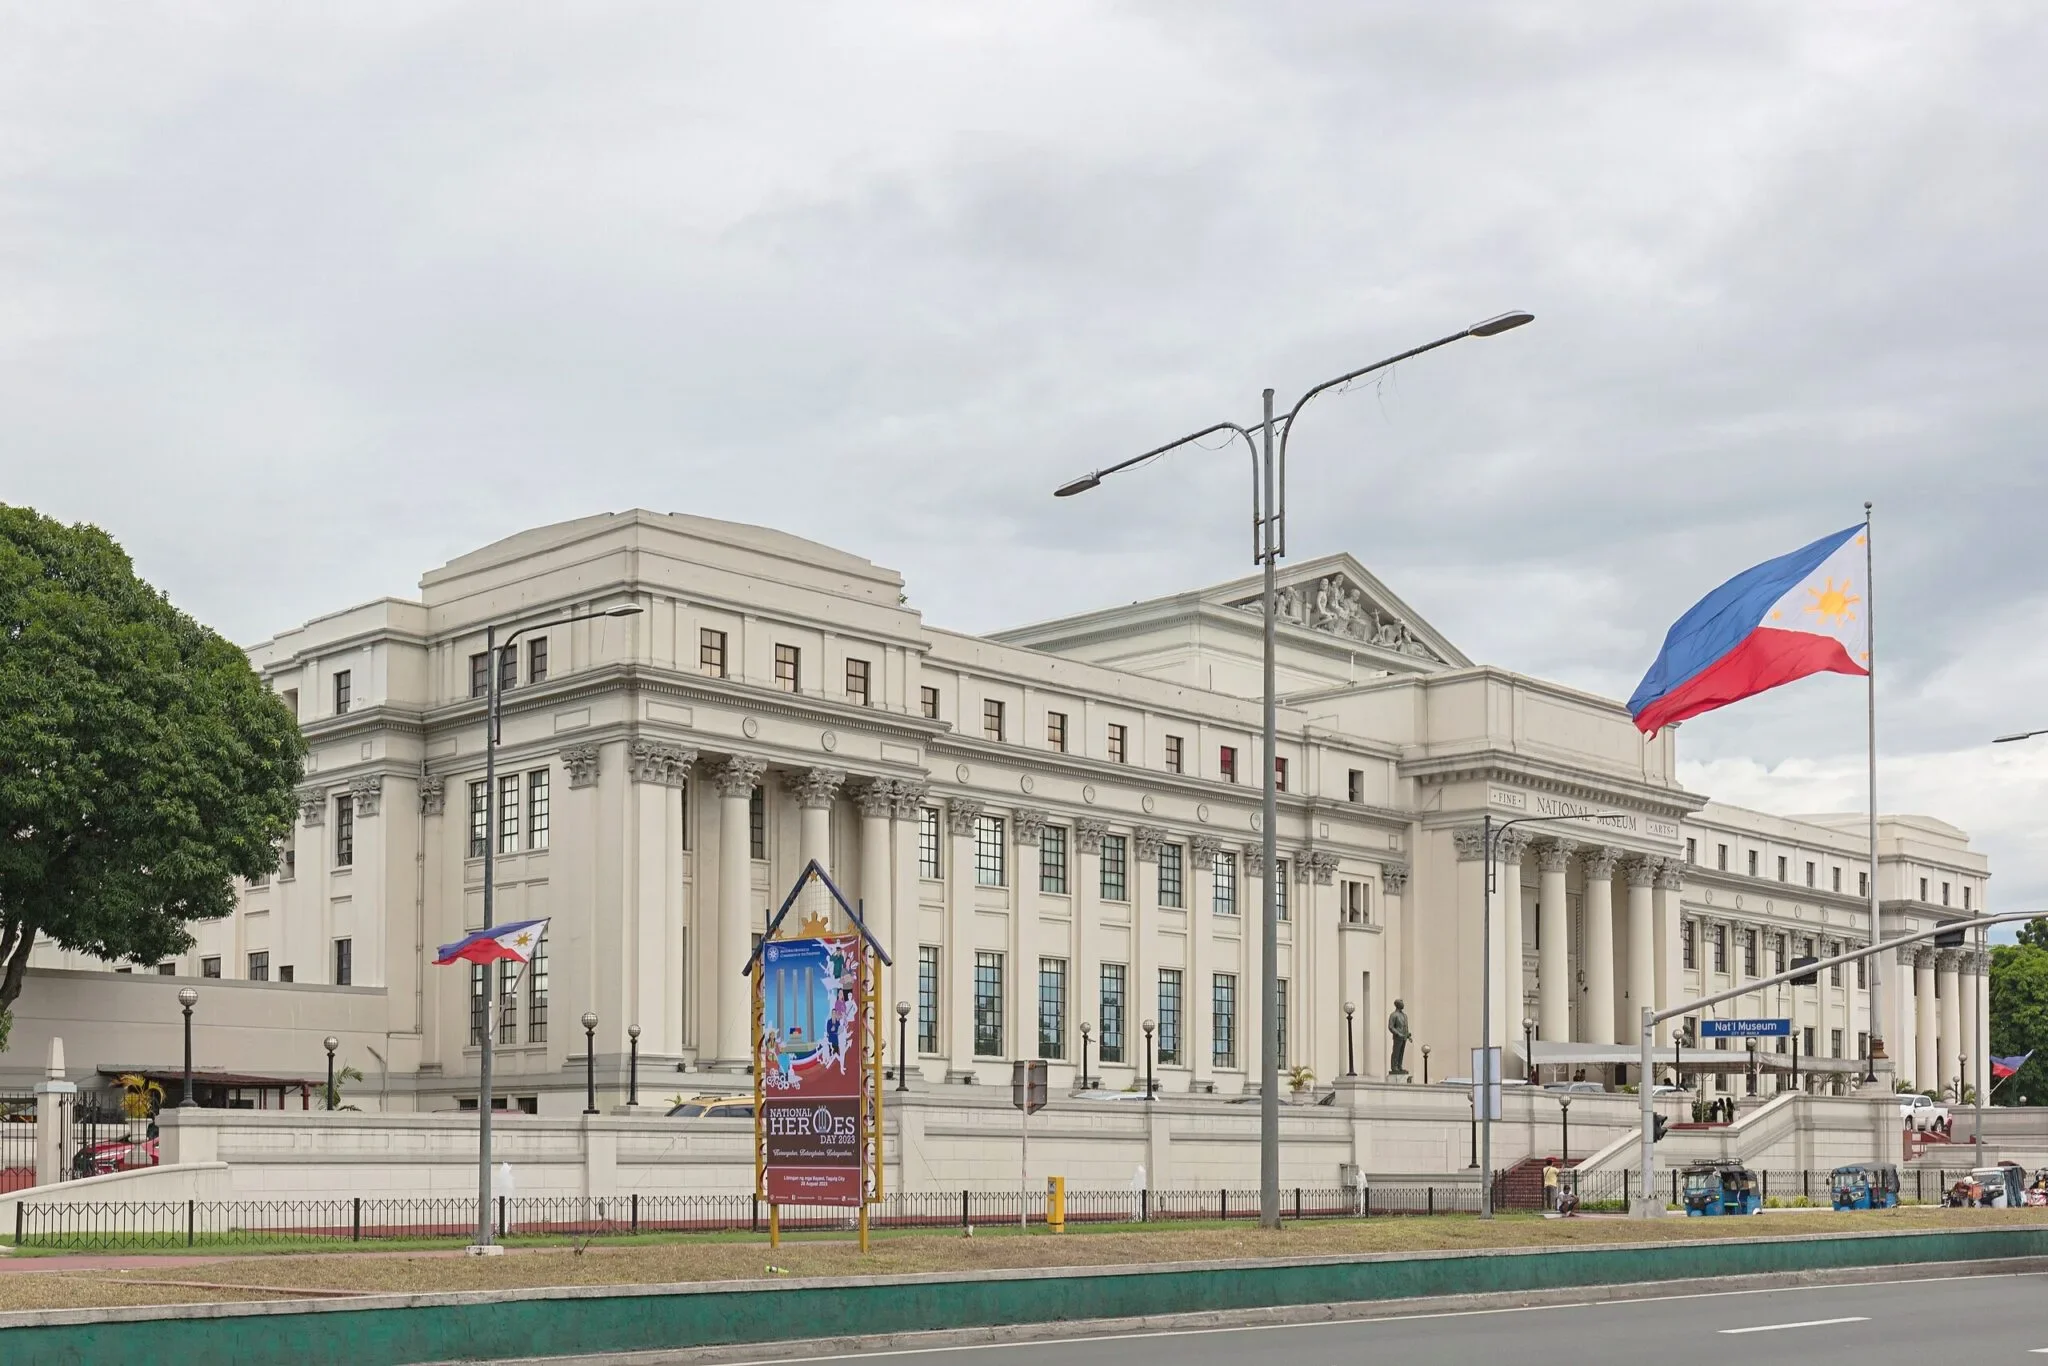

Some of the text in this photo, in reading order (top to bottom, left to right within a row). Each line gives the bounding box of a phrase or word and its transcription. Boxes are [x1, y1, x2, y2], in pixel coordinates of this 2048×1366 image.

[1498, 793, 1517, 805] FINE
[1536, 796, 1591, 822] NATIONAL
[1653, 825, 1671, 834] ARTS
[1715, 1022, 1777, 1031] Nat'l Museum
[770, 1108, 812, 1118] NATIONAL
[770, 1107, 855, 1135] HEROES
[820, 1135, 856, 1144] DAY 2023
